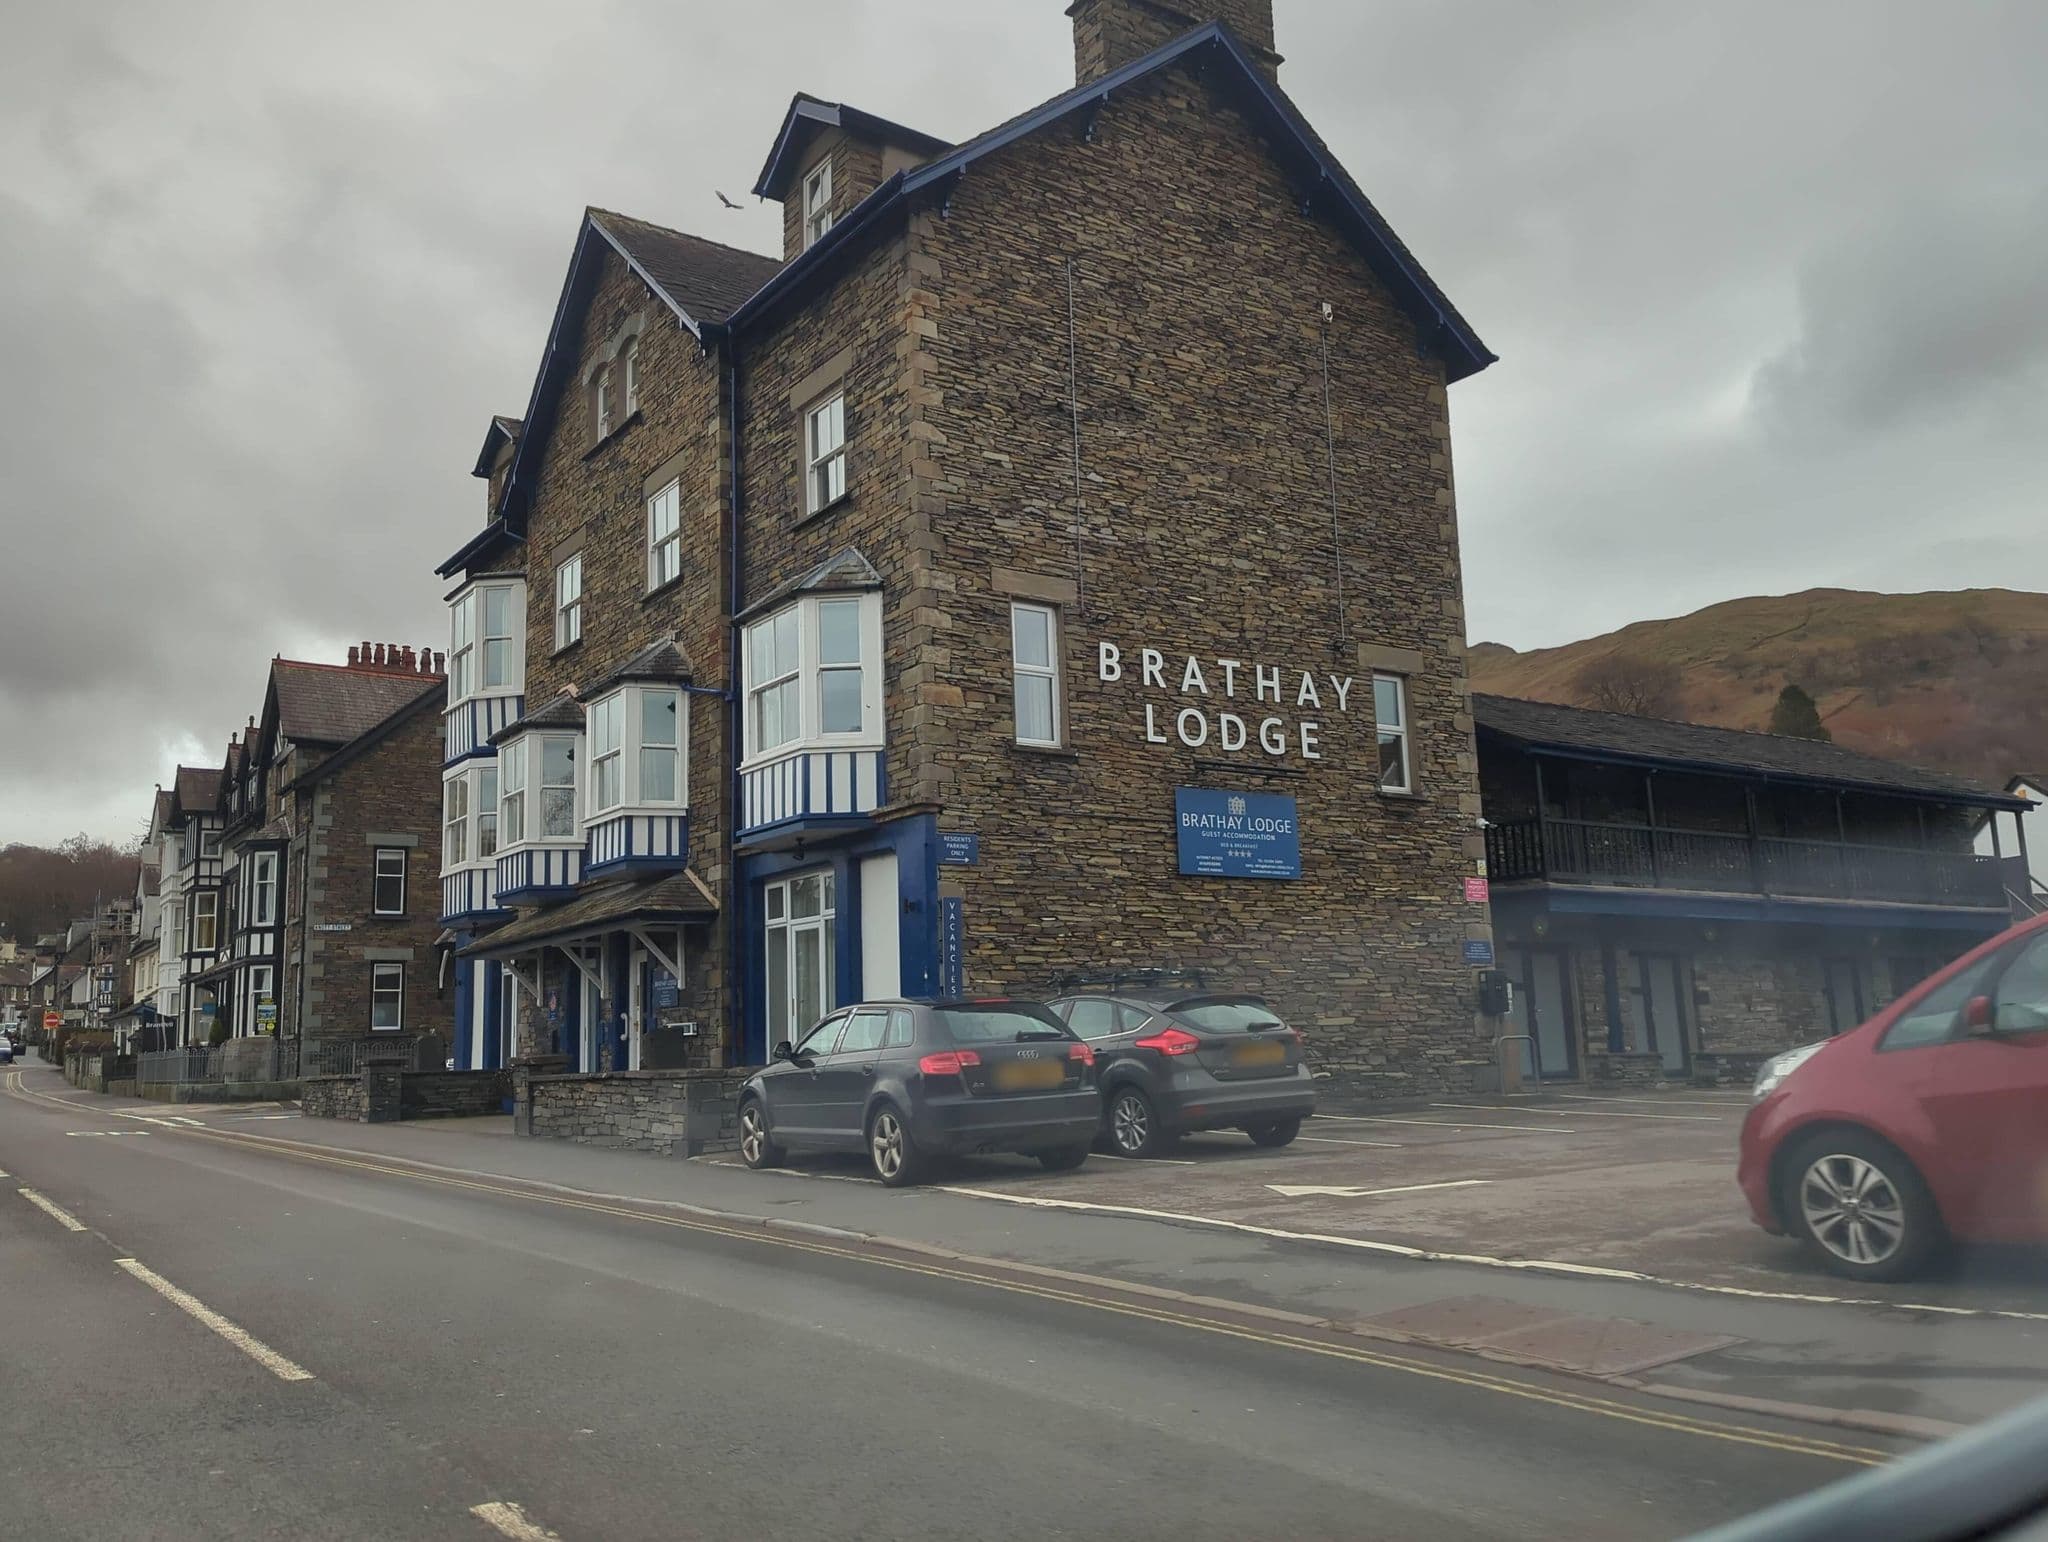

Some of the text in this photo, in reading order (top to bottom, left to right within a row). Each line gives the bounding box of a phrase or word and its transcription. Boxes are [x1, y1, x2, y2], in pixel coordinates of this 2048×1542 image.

[1099, 641, 1353, 712] BRATHAY
[1145, 703, 1321, 759] LODGE
[943, 835, 972, 843] RESIDENTS
[1182, 812, 1292, 834] BRATHAY LODGE
[1201, 830, 1276, 841] GUEST ACCOMMODATION
[949, 902, 957, 994] VACANCIES
